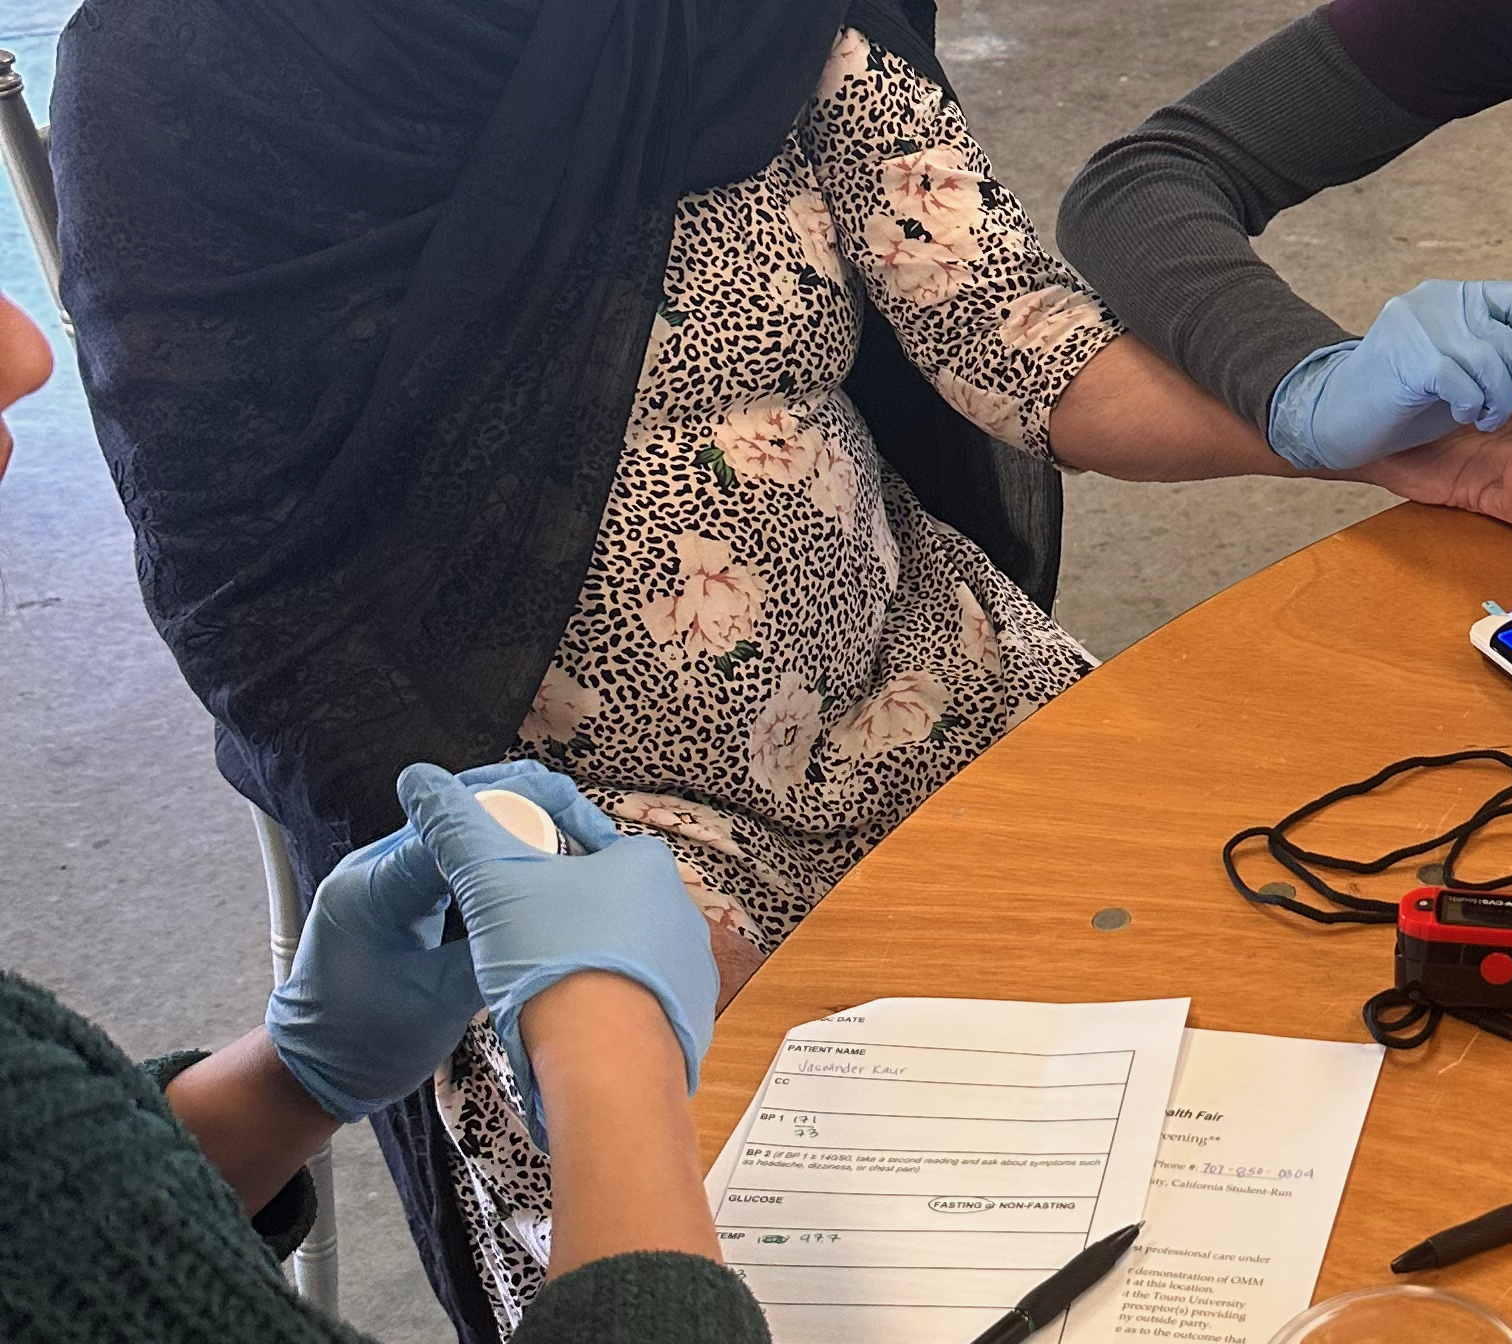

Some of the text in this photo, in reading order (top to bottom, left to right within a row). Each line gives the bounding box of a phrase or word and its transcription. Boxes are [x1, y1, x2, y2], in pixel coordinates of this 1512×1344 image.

[835, 1015, 866, 1023] DATE
[786, 1044, 866, 1055] PATIENT NAME
[773, 1077, 790, 1085] CC
[758, 1112, 776, 1121] BP
[1163, 1107, 1224, 1122] alth Fair
[1170, 1178, 1292, 1197] California Student-Run
[727, 1195, 783, 1204] GLUCOSE
[932, 1200, 982, 1209] FASTING
[998, 1201, 1076, 1210] NON-FASTING
[1143, 1245, 1271, 1264] professional care under
[1134, 1266, 1215, 1282] demonstration
[1229, 1275, 1264, 1286] OMM
[1145, 1279, 1167, 1288] this
[1168, 1281, 1214, 1294] location.
[1152, 1291, 1186, 1303] Touro
[1187, 1294, 1246, 1310] University
[1134, 1314, 1177, 1325] outside
[1189, 1308, 1247, 1322] providing
[1172, 1331, 1222, 1342] outcome
[1223, 1334, 1247, 1344] that
